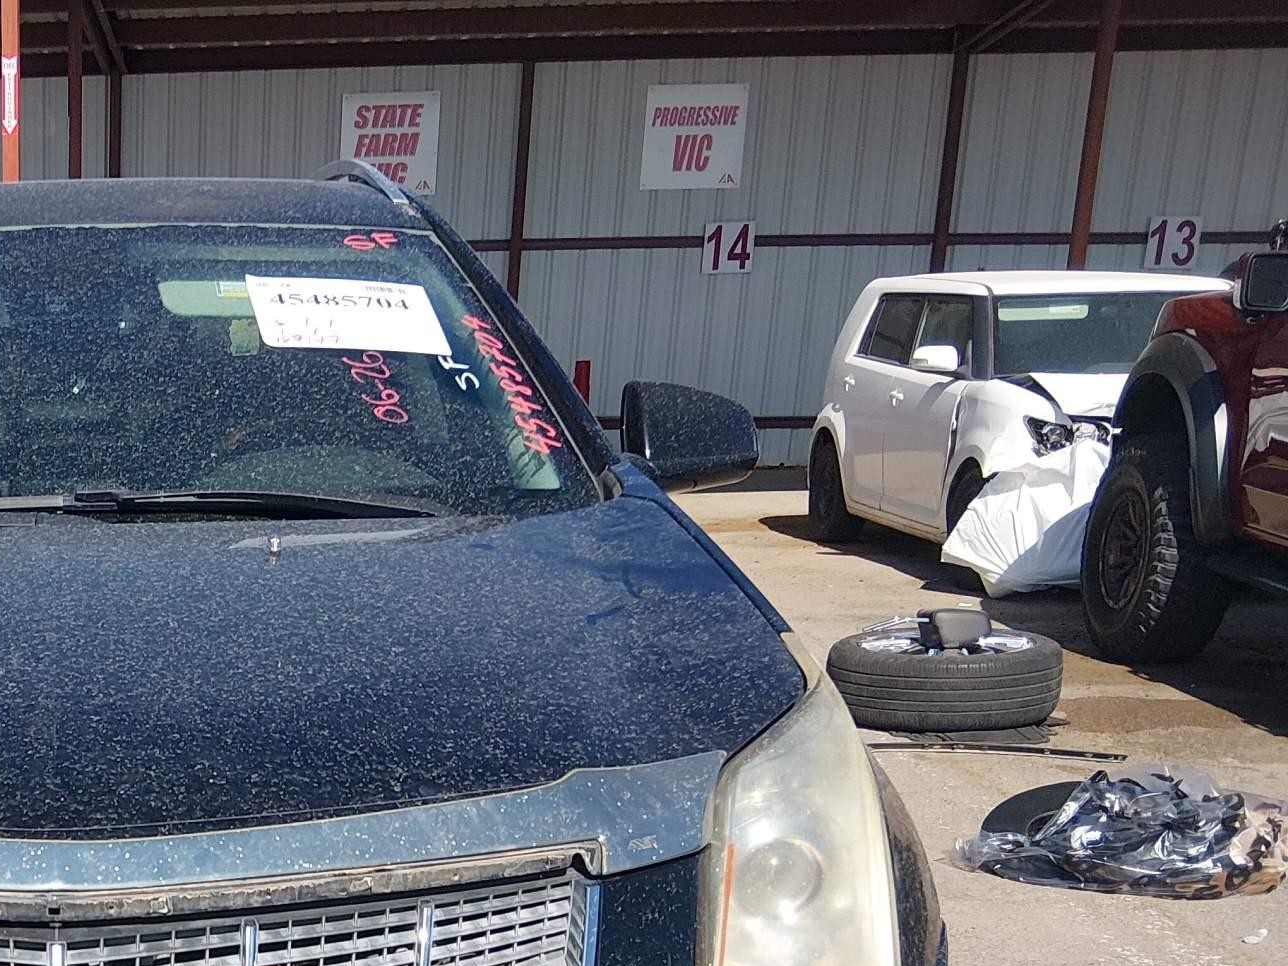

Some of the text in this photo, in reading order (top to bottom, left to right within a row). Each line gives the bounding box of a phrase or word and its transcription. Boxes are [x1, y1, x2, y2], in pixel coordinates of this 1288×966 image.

[354, 103, 424, 129] STATE
[651, 105, 740, 127] PROGRESSIVE
[353, 132, 420, 158] FARM
[672, 133, 713, 172] VIC
[343, 232, 398, 250] SF
[706, 223, 751, 271] 14
[1150, 219, 1197, 266] 13
[270, 292, 410, 310] 45485704
